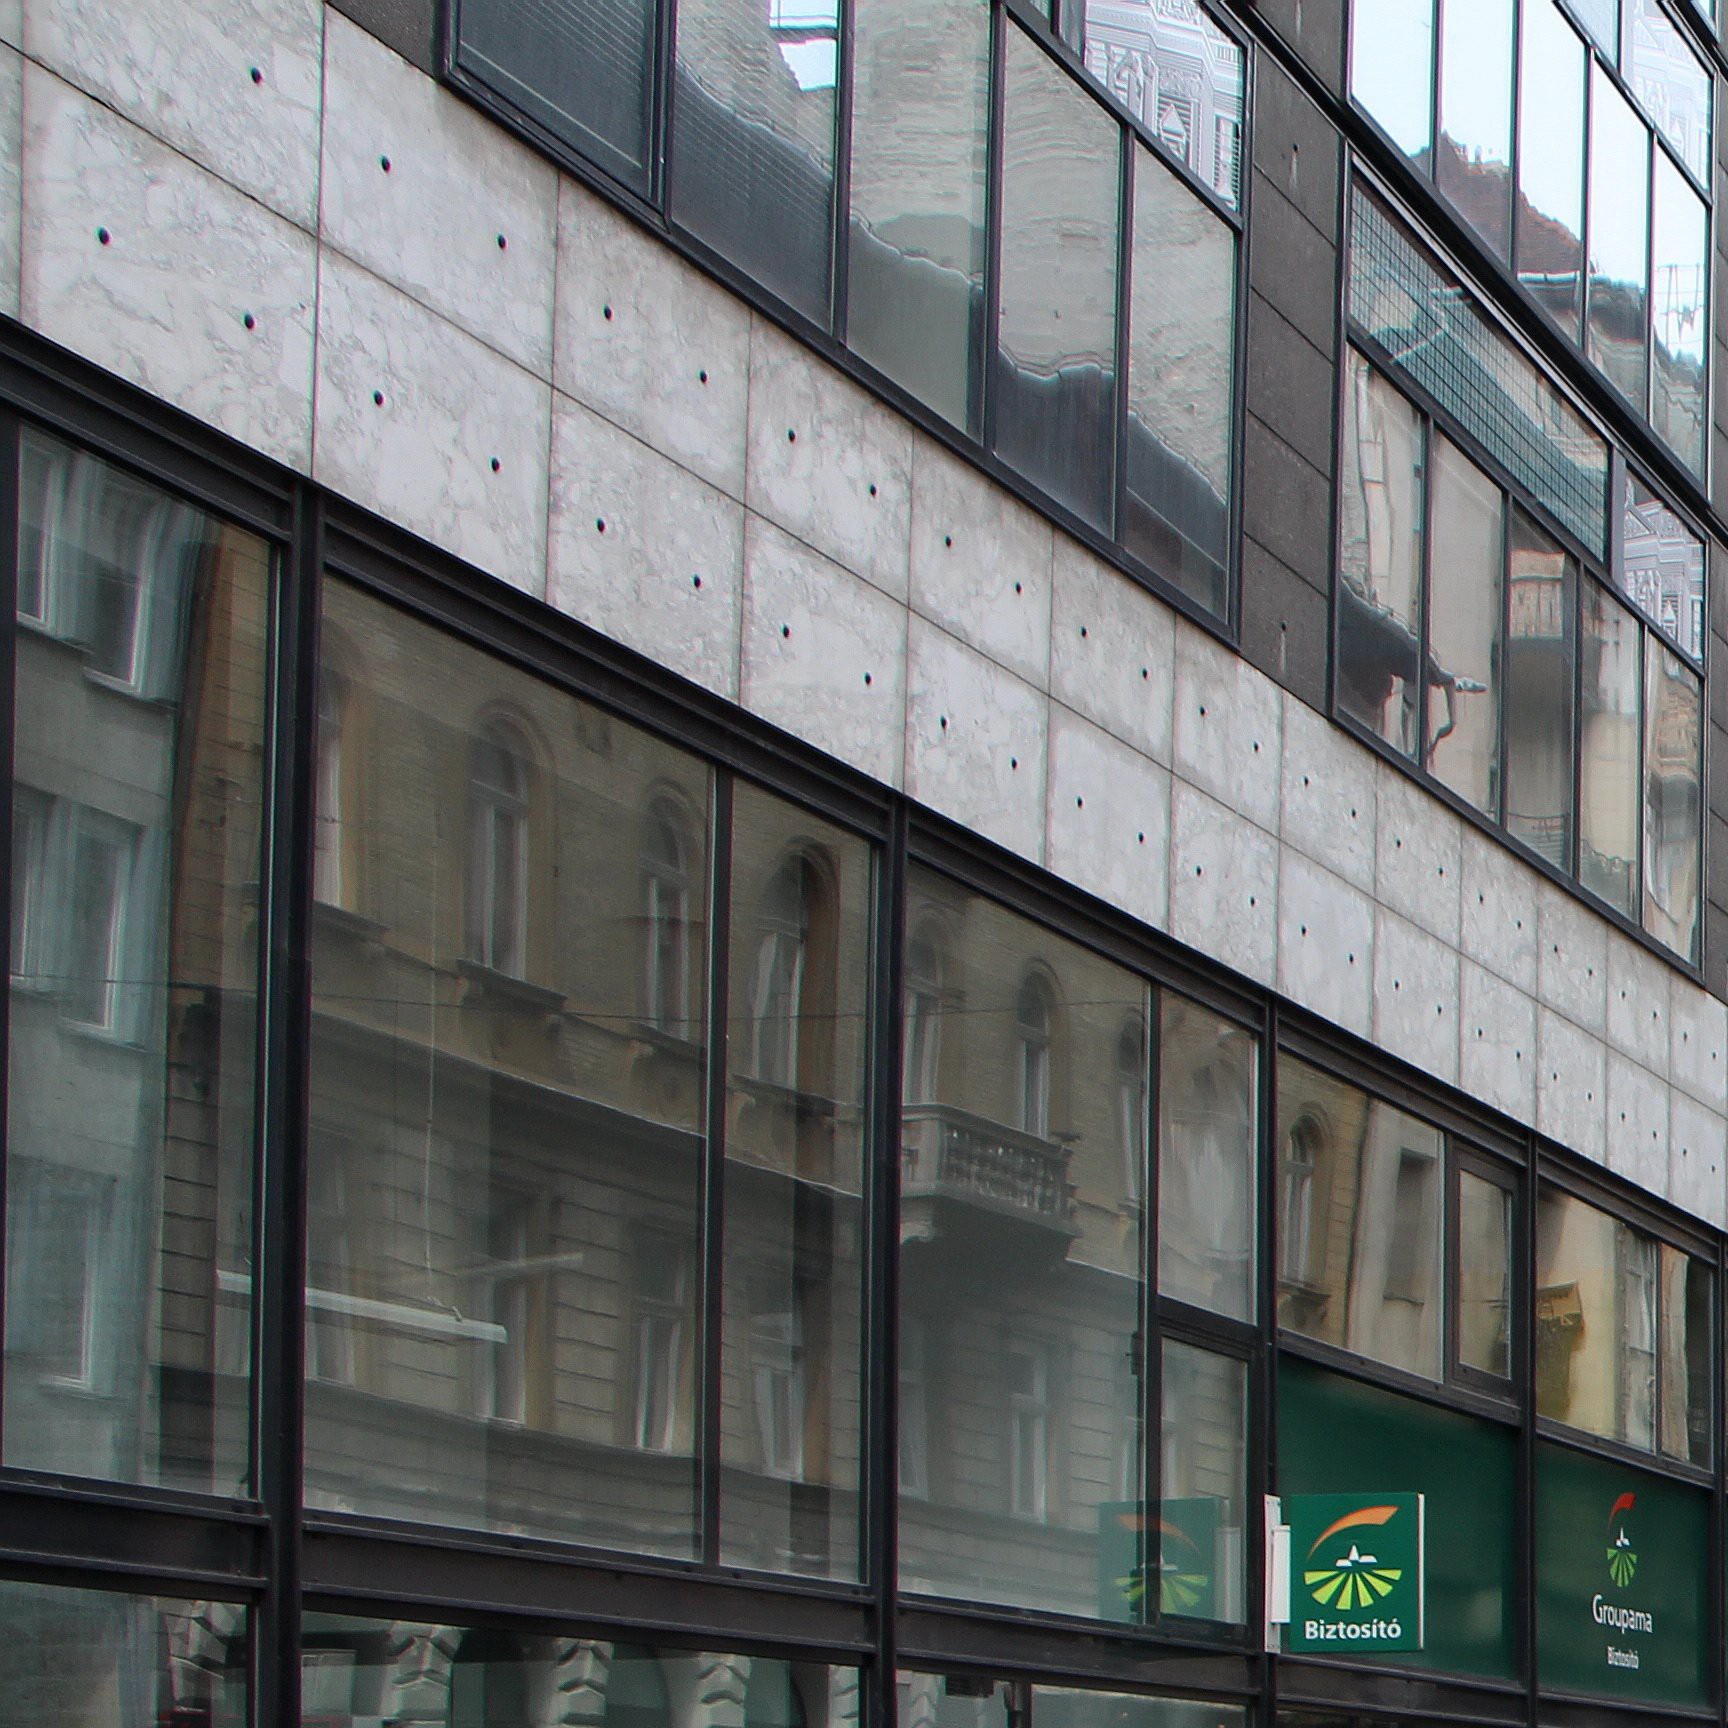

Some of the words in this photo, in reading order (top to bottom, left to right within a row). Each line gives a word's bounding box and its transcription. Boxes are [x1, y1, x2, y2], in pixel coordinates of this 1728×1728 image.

[1592, 1594, 1653, 1635] Groupama
[1304, 1617, 1402, 1640] Biztosító
[1607, 1646, 1639, 1670] Biztosító
